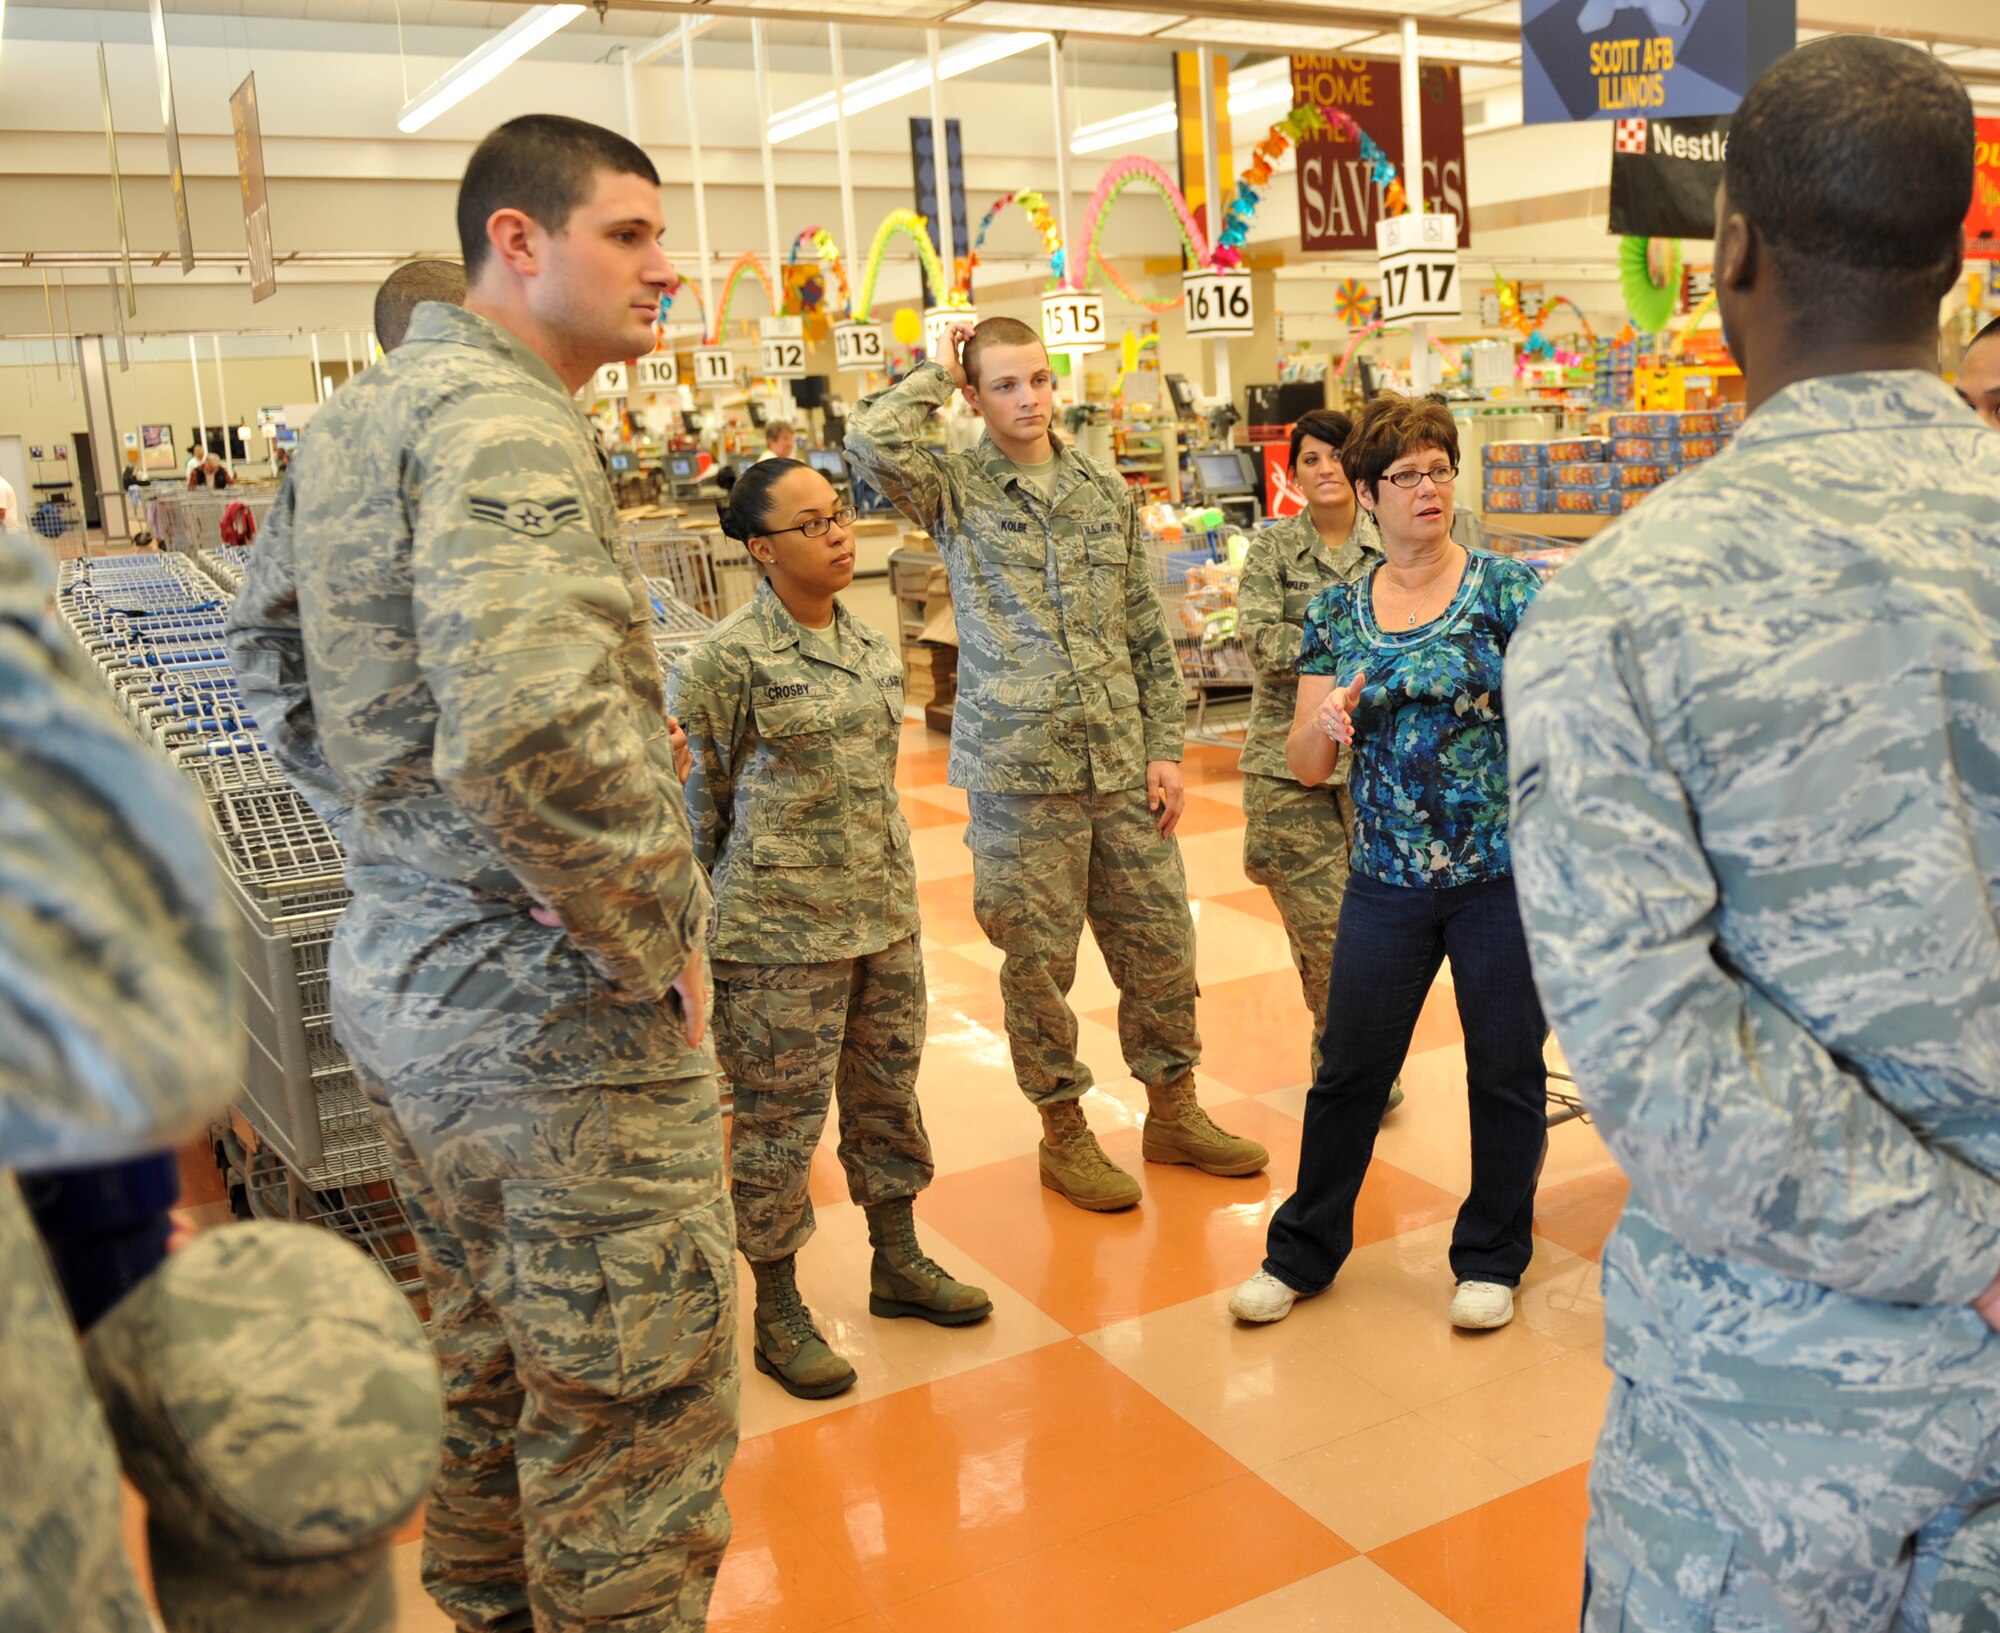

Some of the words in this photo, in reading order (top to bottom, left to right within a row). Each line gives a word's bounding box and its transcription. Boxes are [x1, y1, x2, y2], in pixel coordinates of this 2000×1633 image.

[1590, 38, 1640, 75] SCOTT
[1642, 37, 1674, 72] AFB
[1294, 72, 1374, 107] HOME
[1598, 73, 1665, 111] ILLINOIS
[1383, 265, 1410, 308] 17
[1416, 263, 1455, 302] 17
[1186, 286, 1209, 321] 16
[1213, 285, 1249, 318] 16
[1046, 306, 1064, 335] 15
[1069, 304, 1101, 334] 15
[774, 345, 802, 367] 12
[851, 332, 880, 356] 13
[606, 369, 619, 387] 9
[650, 362, 673, 381] 10
[708, 356, 728, 377] 11
[1001, 520, 1028, 533] KOLBE
[768, 683, 810, 700] CROSBY
